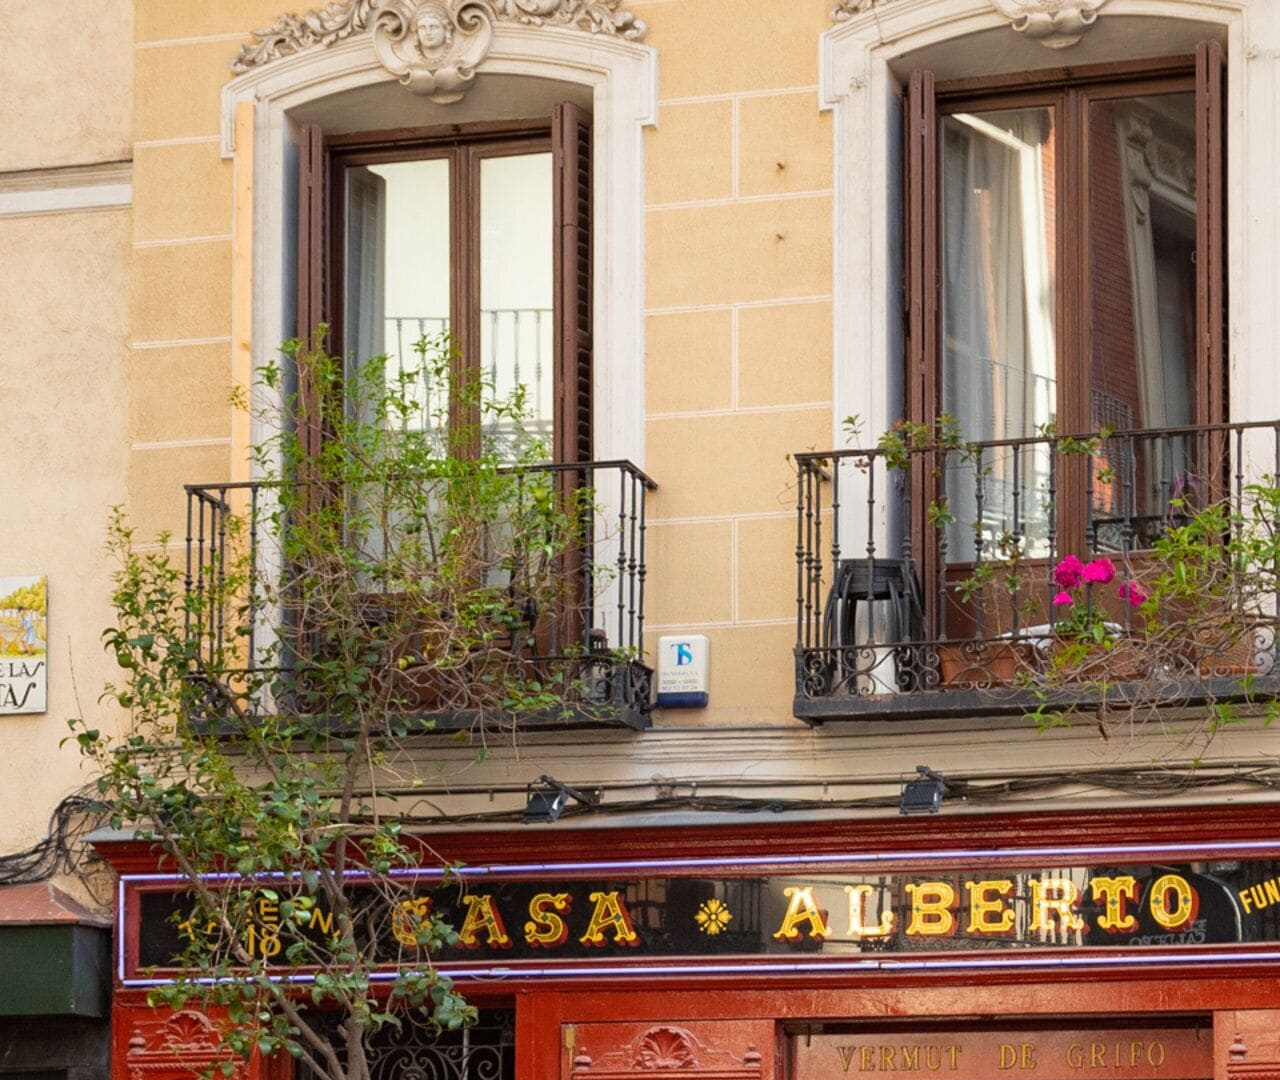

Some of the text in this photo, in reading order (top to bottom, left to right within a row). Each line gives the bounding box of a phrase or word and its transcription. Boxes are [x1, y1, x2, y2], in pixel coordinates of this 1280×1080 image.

[9, 660, 45, 679] LAS
[773, 873, 1200, 940] ALBERTO
[837, 1039, 1166, 1072] VERMUT DE GRIFO
